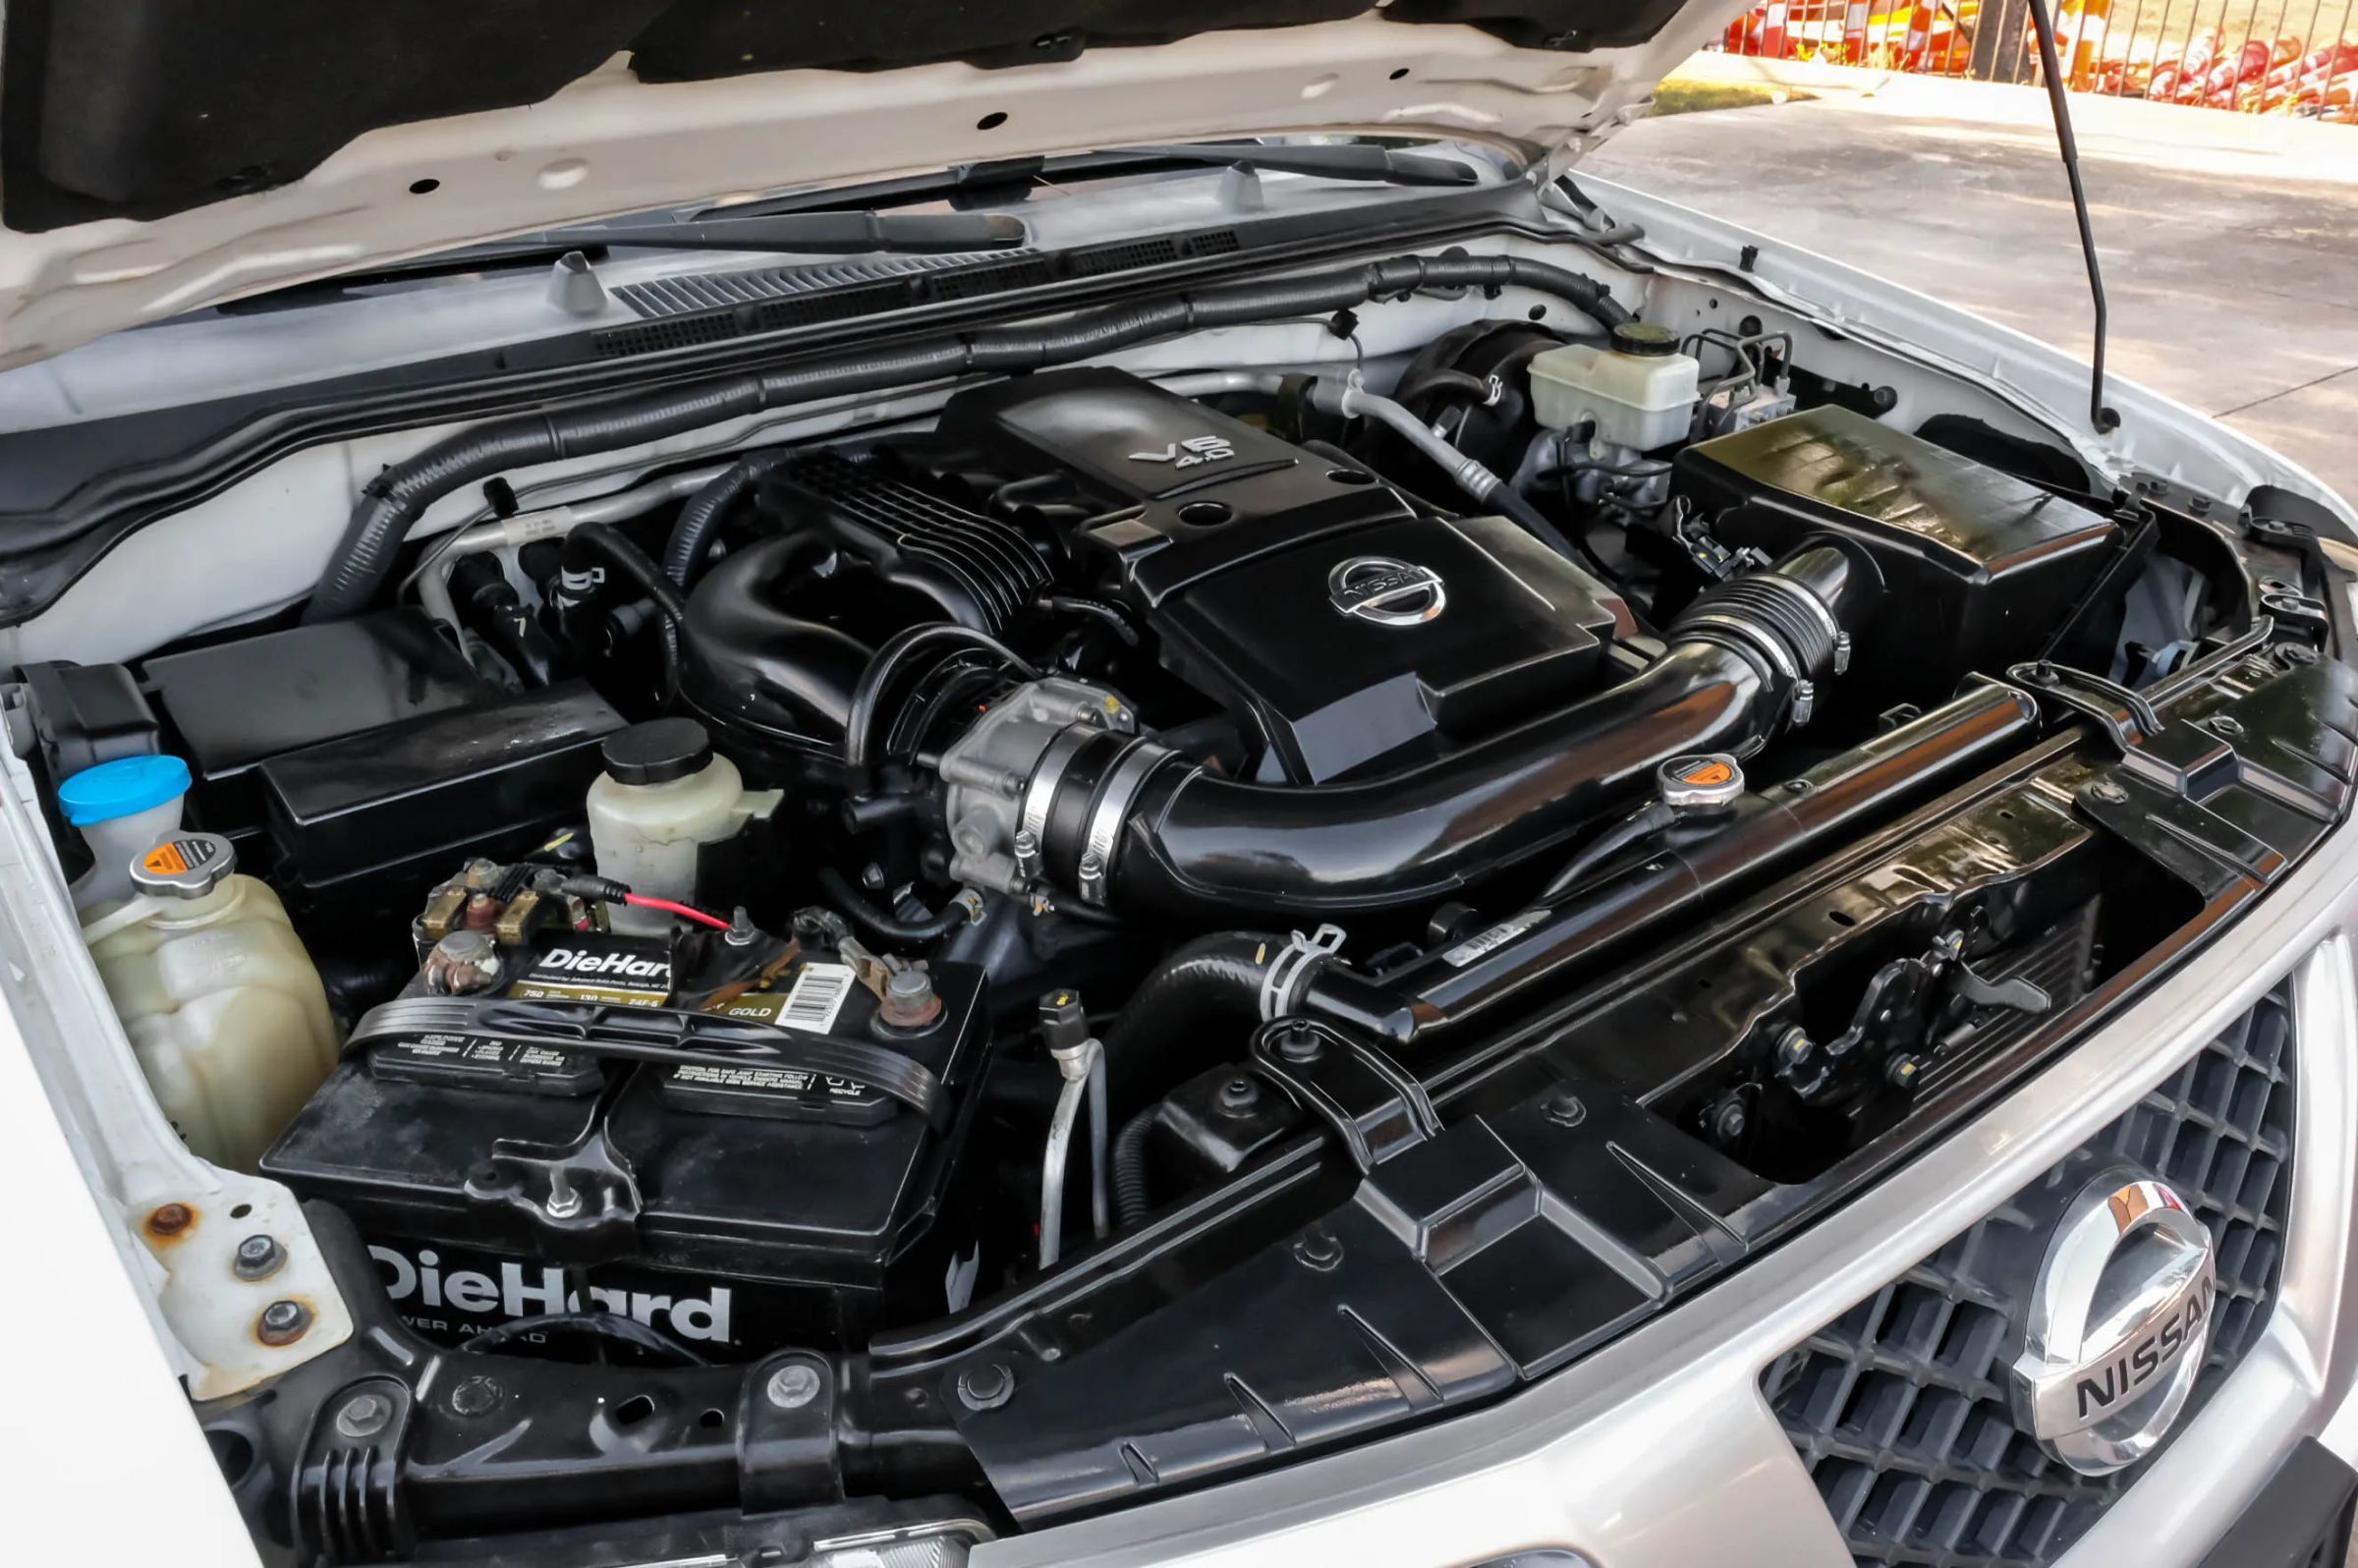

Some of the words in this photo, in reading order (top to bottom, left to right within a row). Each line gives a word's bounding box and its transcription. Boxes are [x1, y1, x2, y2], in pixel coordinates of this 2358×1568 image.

[1175, 448, 1235, 469] 4.0
[538, 948, 670, 978] DieHar
[729, 1008, 772, 1018] GOLD
